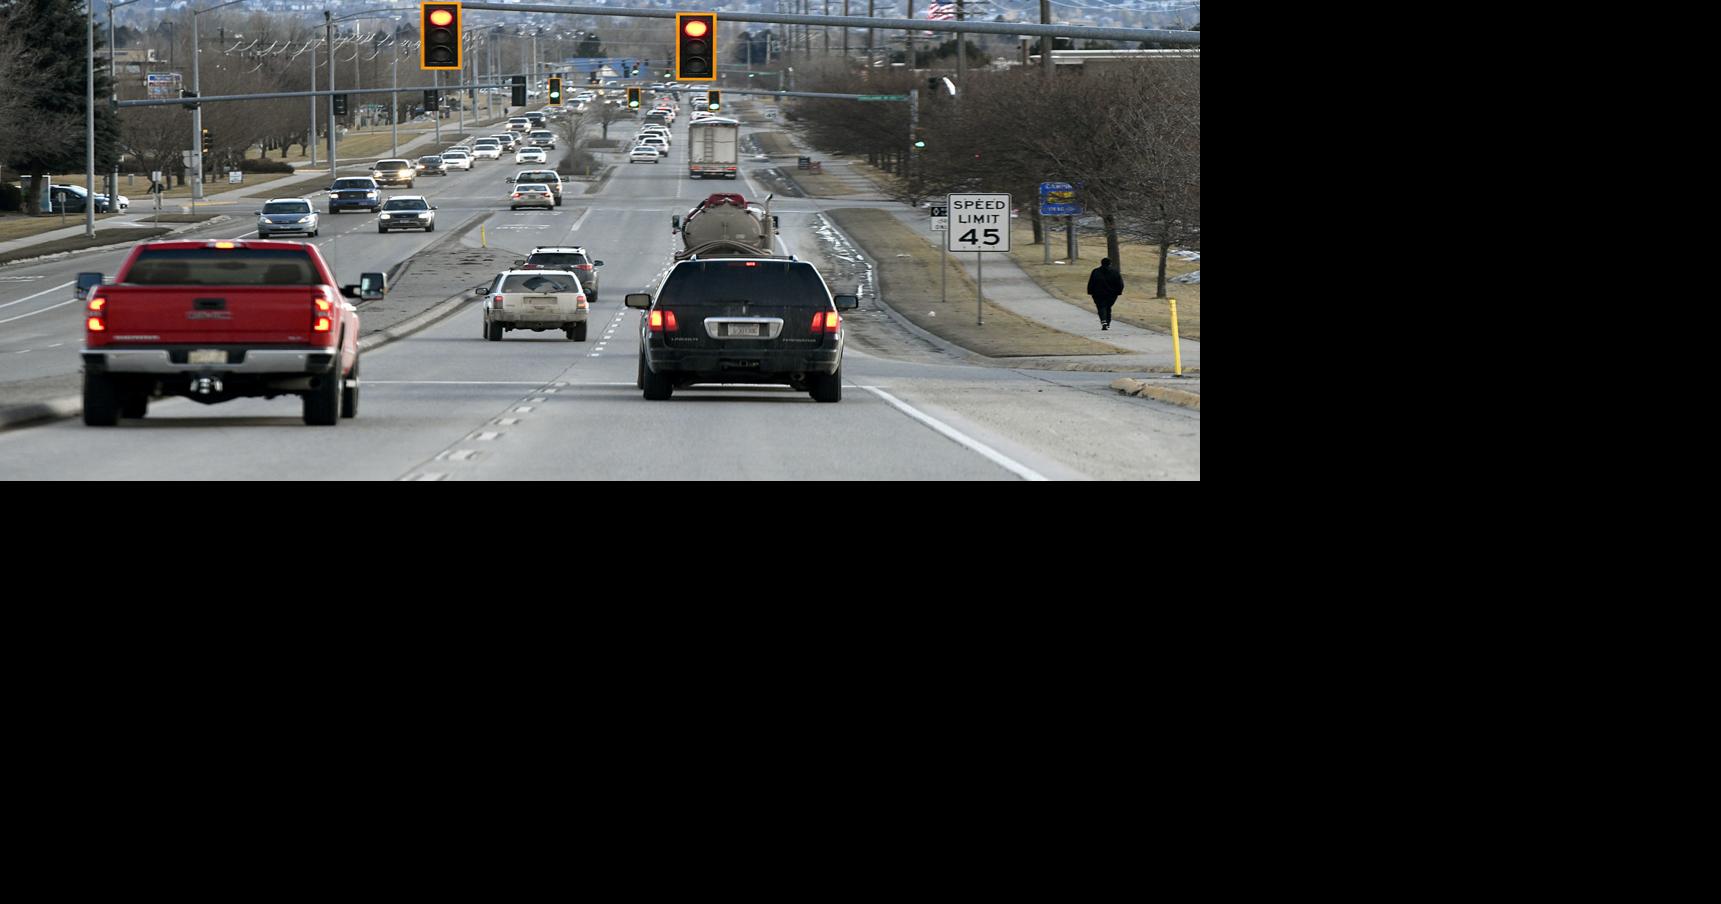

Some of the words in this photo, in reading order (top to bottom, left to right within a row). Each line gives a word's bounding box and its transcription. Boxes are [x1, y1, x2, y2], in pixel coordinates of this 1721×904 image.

[953, 200, 1005, 210] SPEED
[958, 214, 1000, 224] LIMIT
[958, 228, 1000, 246] 45
